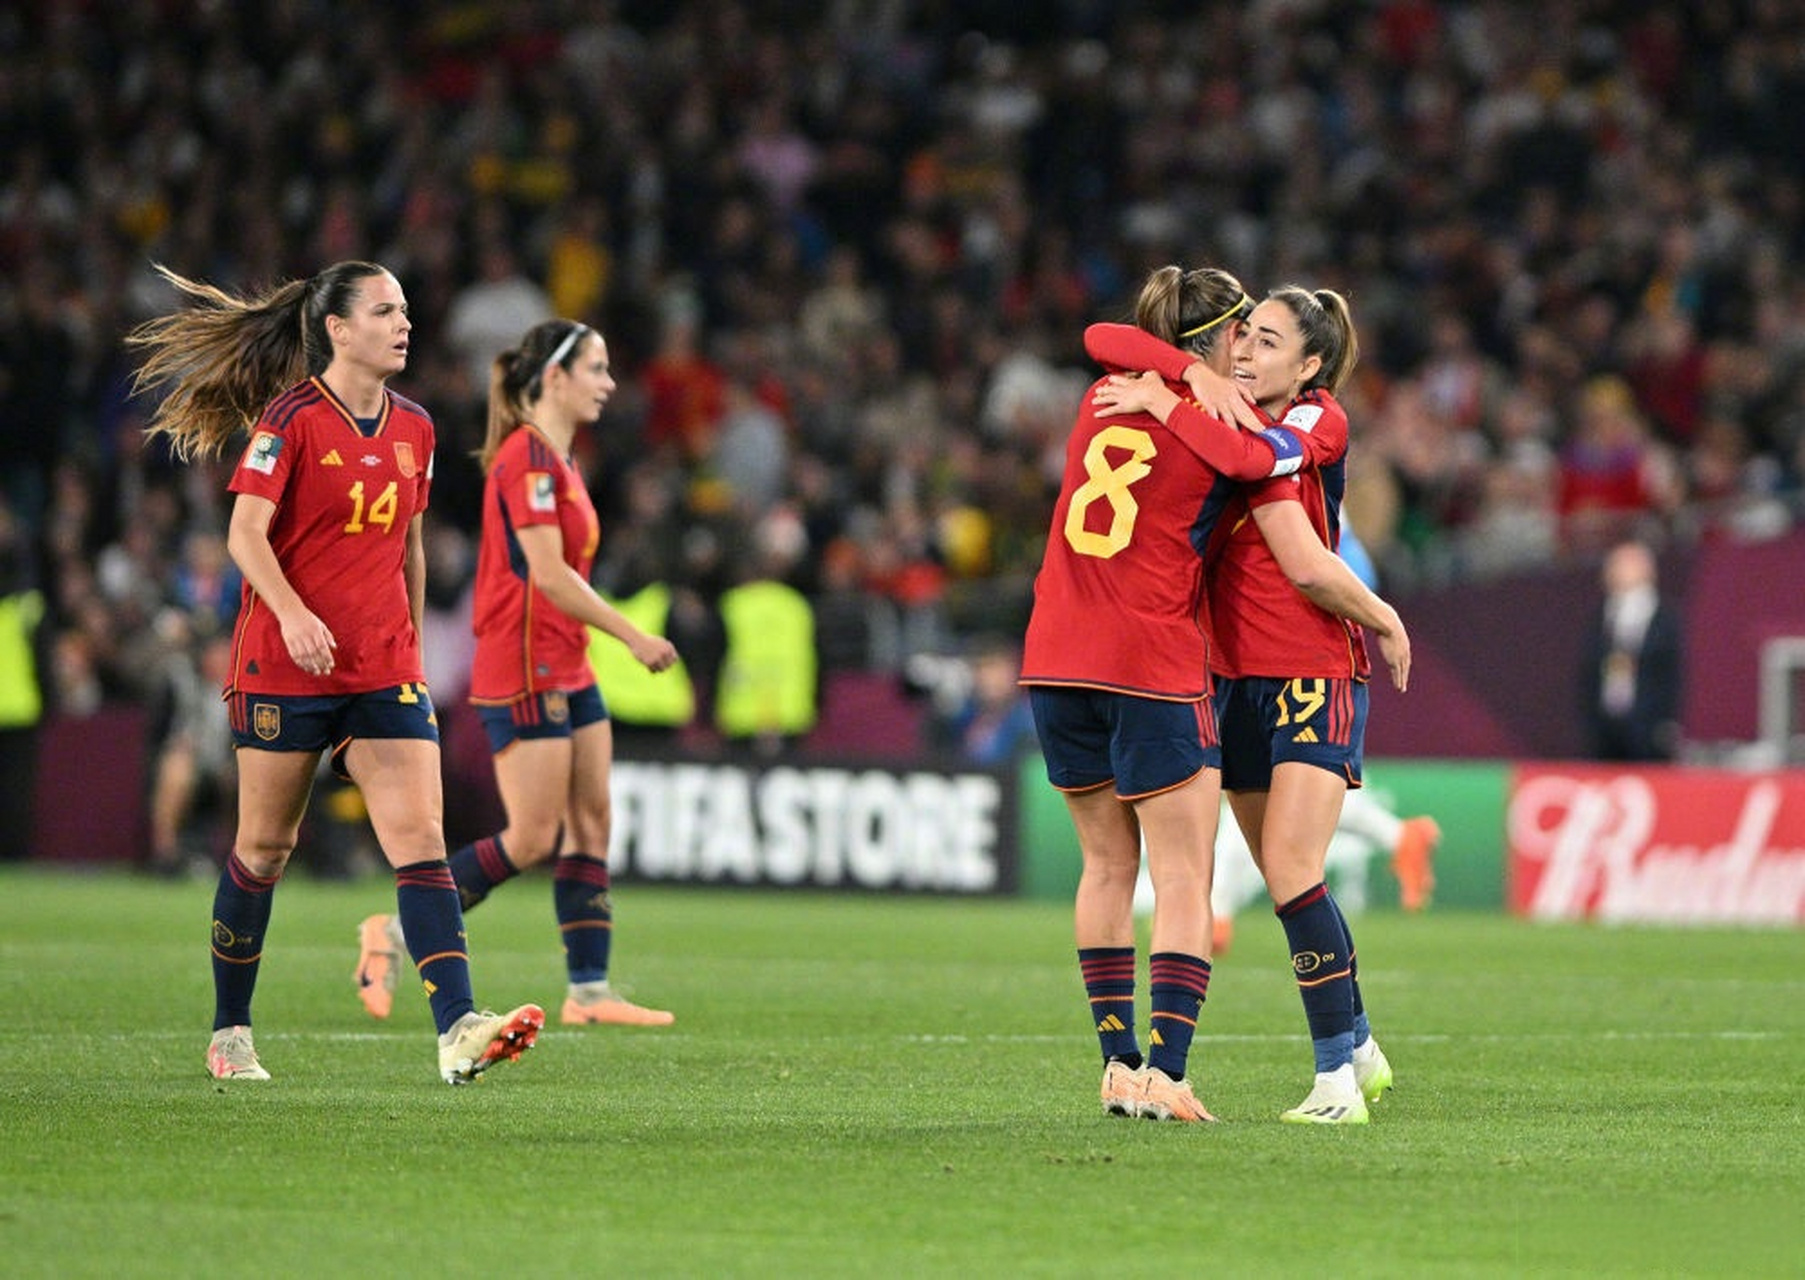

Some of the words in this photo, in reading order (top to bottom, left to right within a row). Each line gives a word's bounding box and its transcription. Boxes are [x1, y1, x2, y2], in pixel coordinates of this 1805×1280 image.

[344, 481, 398, 534] 14
[1064, 425, 1158, 559] 8
[1276, 678, 1326, 727] 19
[611, 763, 757, 880] FIFA
[755, 766, 999, 890] STORE
